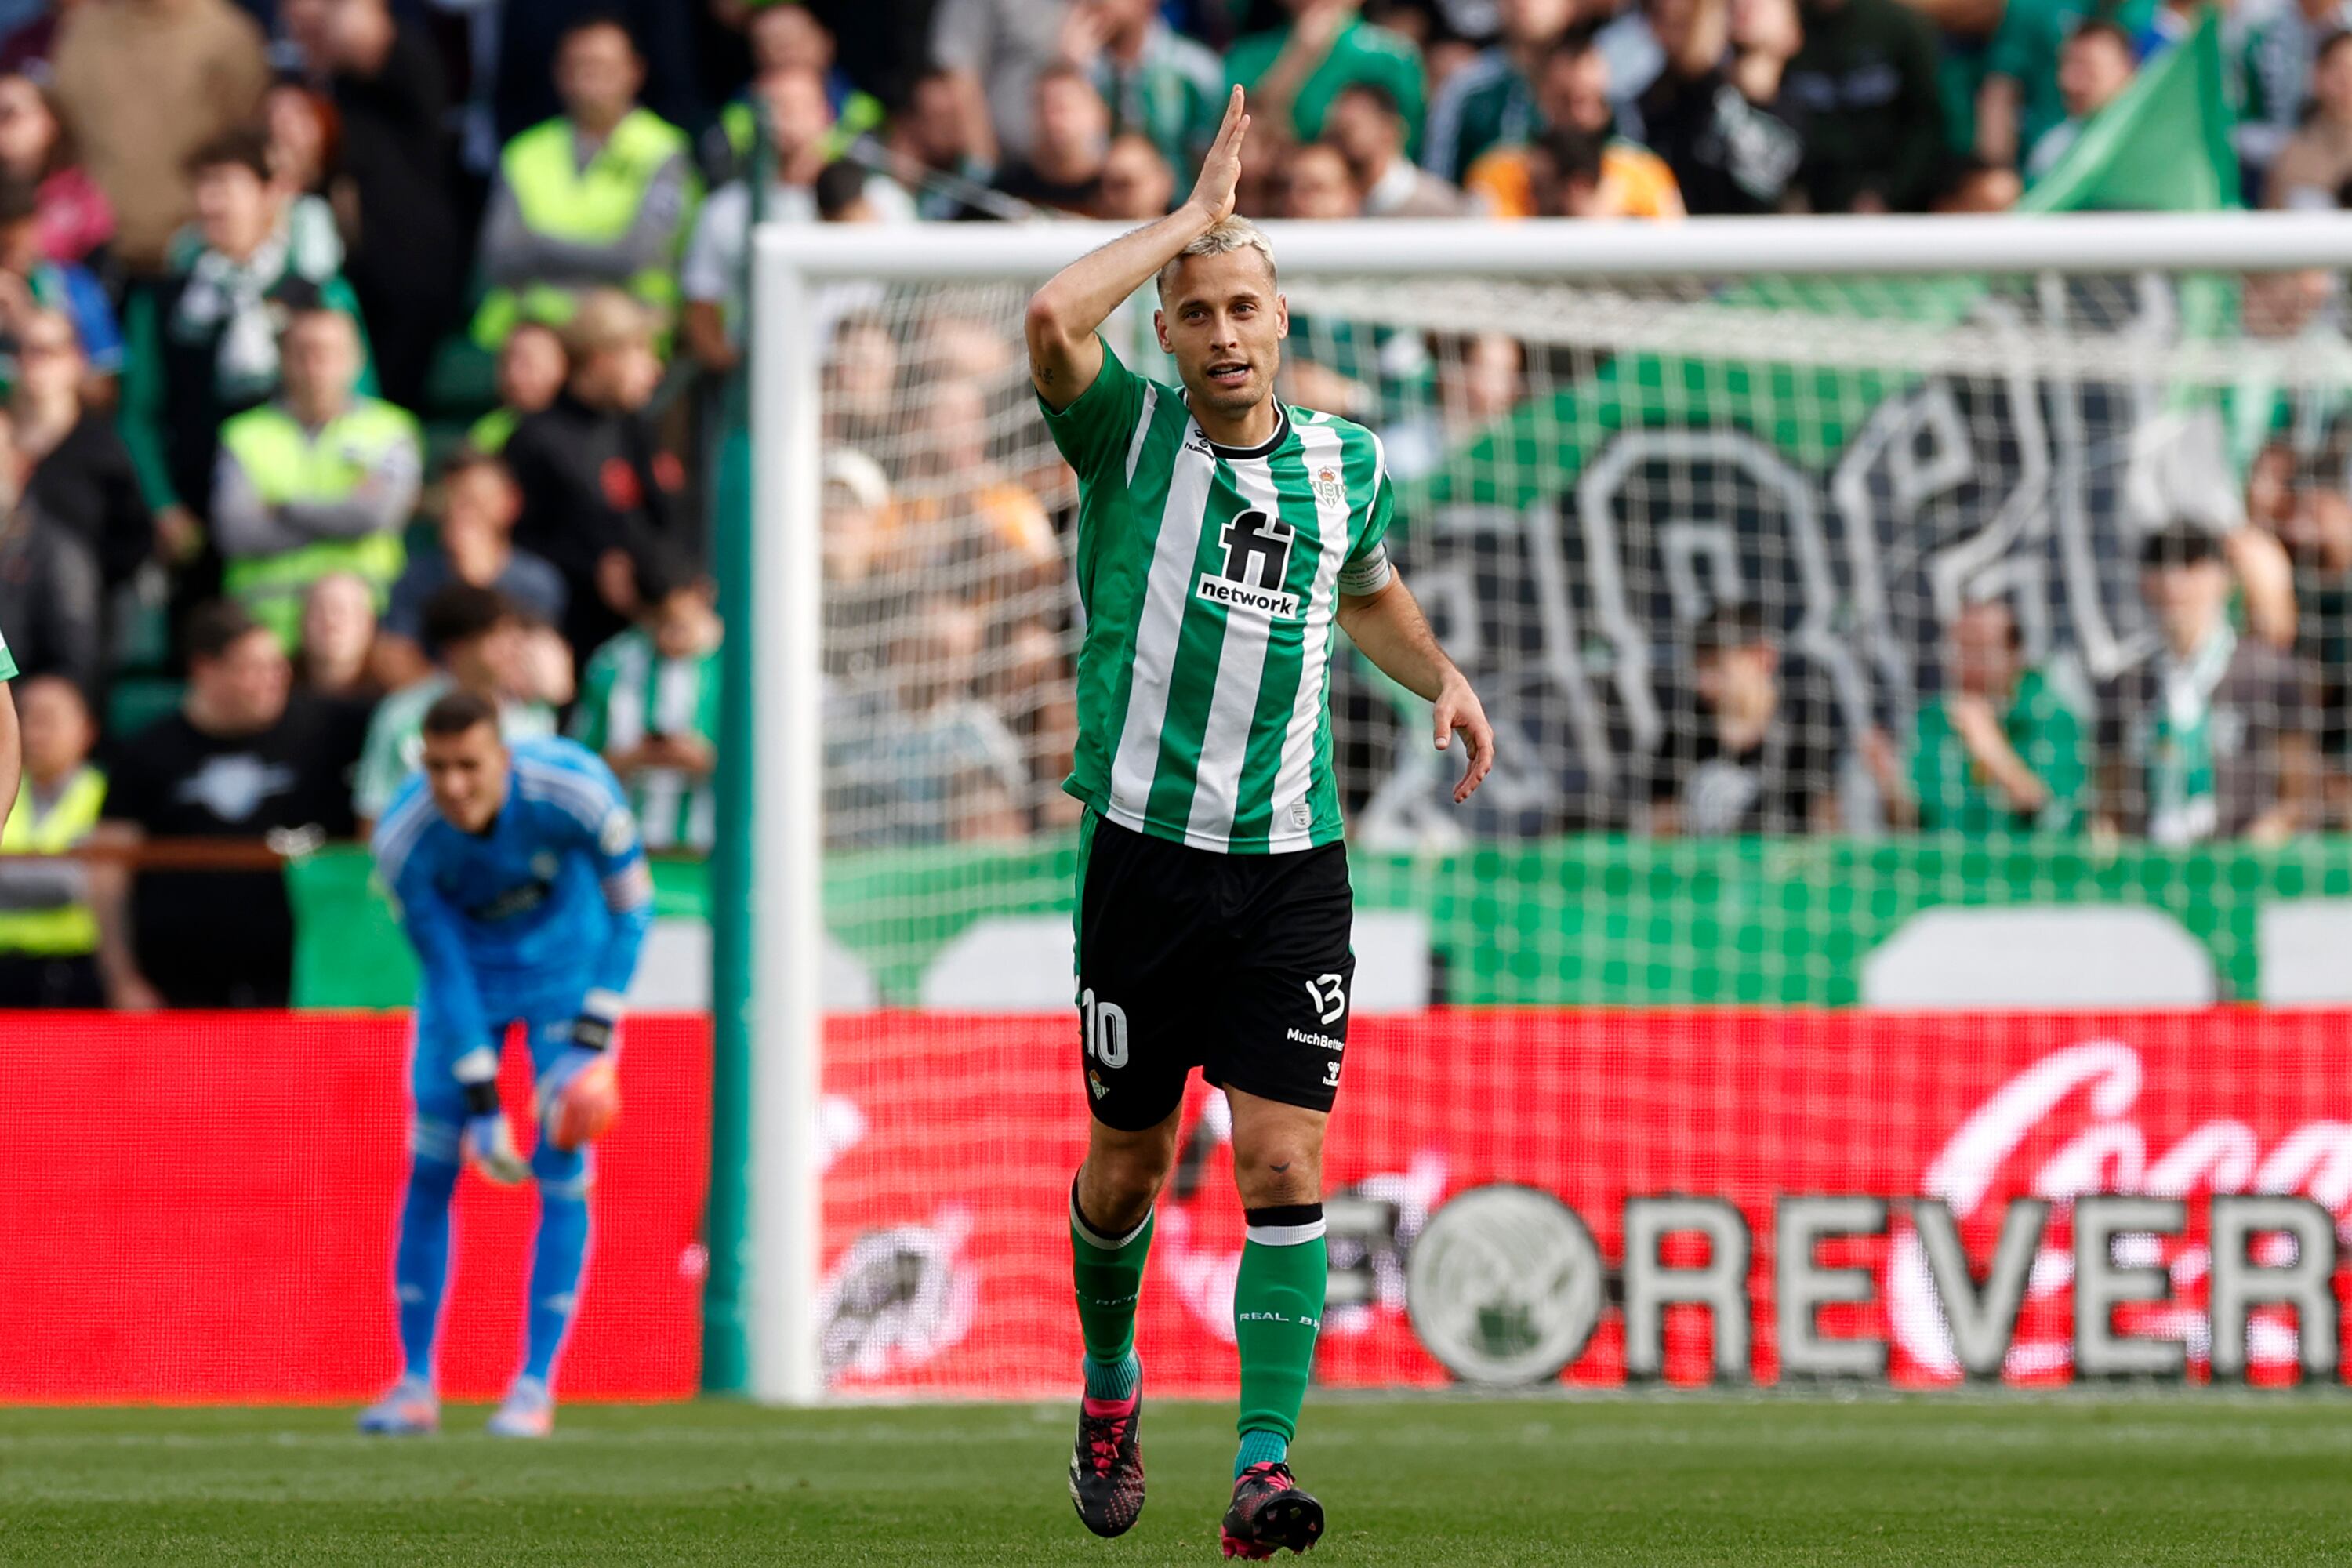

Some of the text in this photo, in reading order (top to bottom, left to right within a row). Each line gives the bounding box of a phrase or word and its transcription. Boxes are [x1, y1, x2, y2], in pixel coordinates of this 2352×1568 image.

[1202, 582, 1294, 615] network
[1082, 988, 1129, 1069] 10
[1240, 1312, 1290, 1322] REAL
